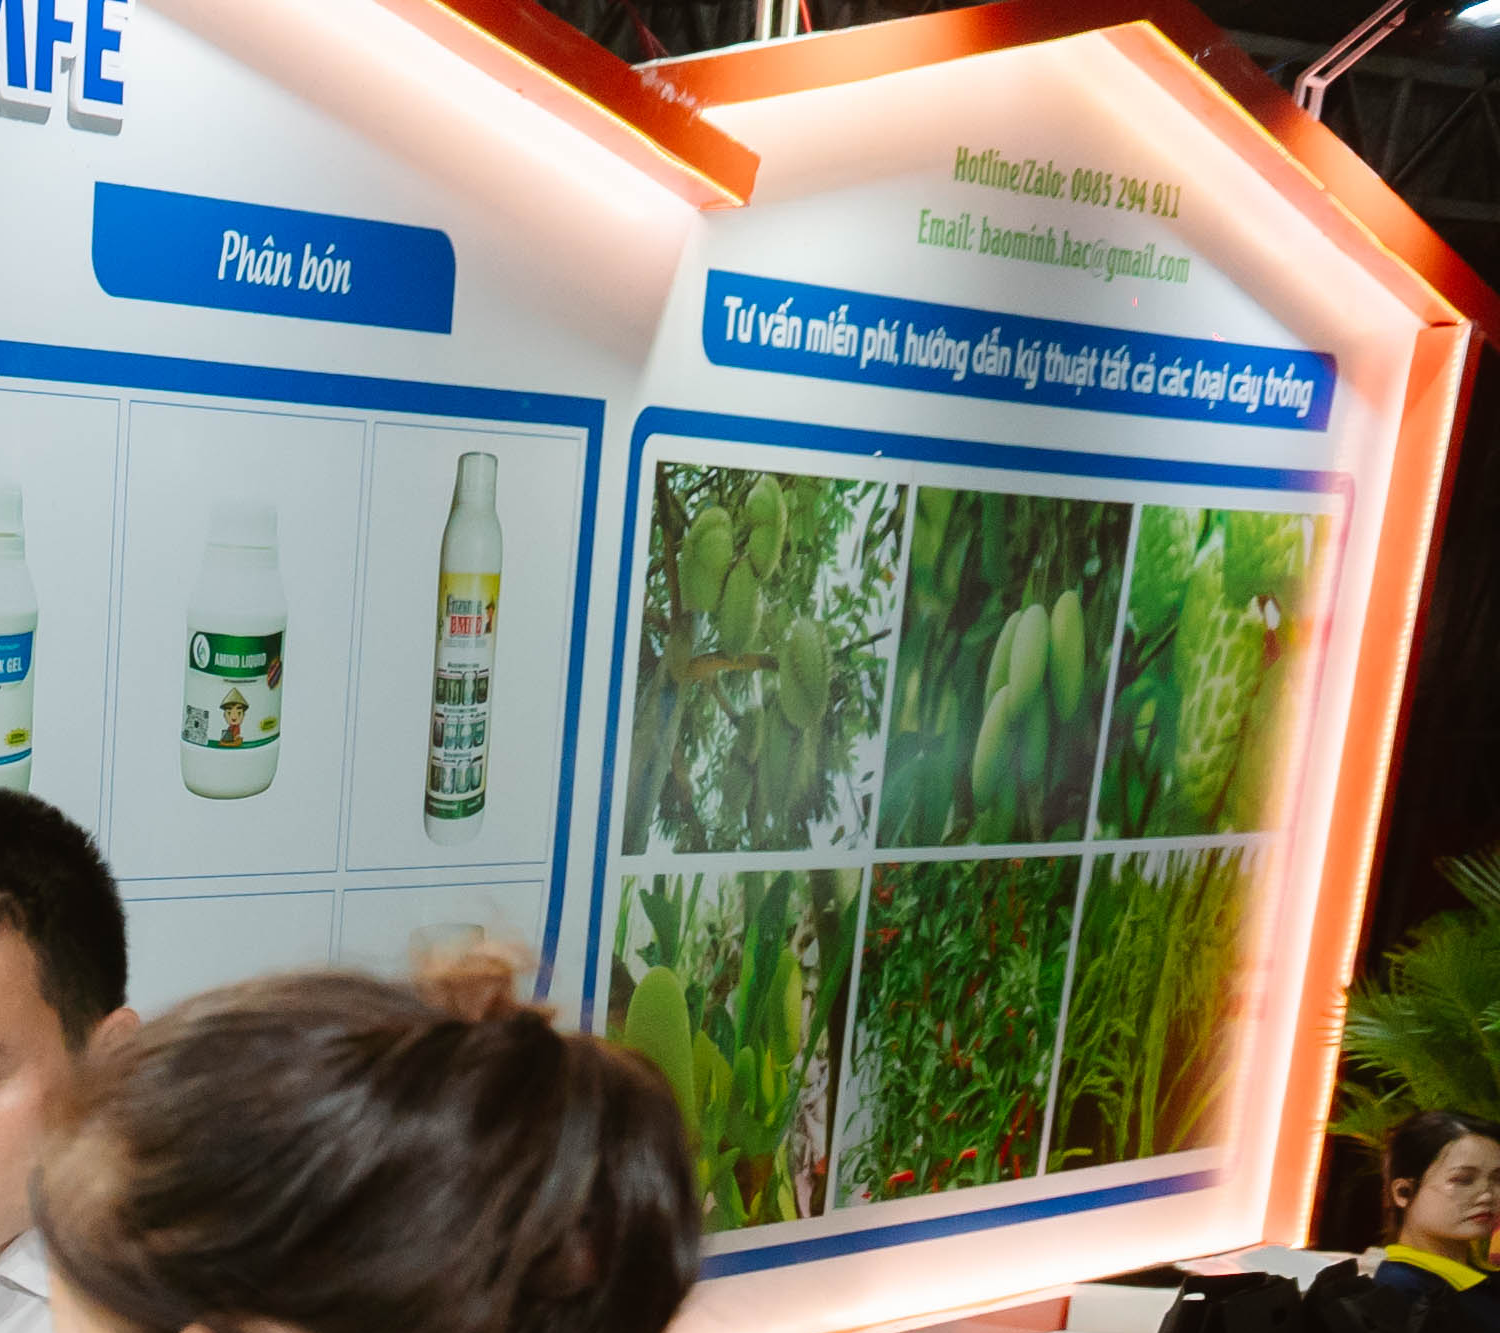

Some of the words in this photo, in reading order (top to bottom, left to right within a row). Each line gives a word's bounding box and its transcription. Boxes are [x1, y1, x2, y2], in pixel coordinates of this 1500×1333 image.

[1152, 183, 1181, 218] 911
[918, 209, 975, 250] Email:
[217, 230, 292, 288] Phân
[298, 243, 352, 294] bón
[724, 296, 757, 342] Tư
[759, 297, 802, 350] vấn
[805, 305, 859, 358] miễn
[973, 327, 1011, 376] dẫn
